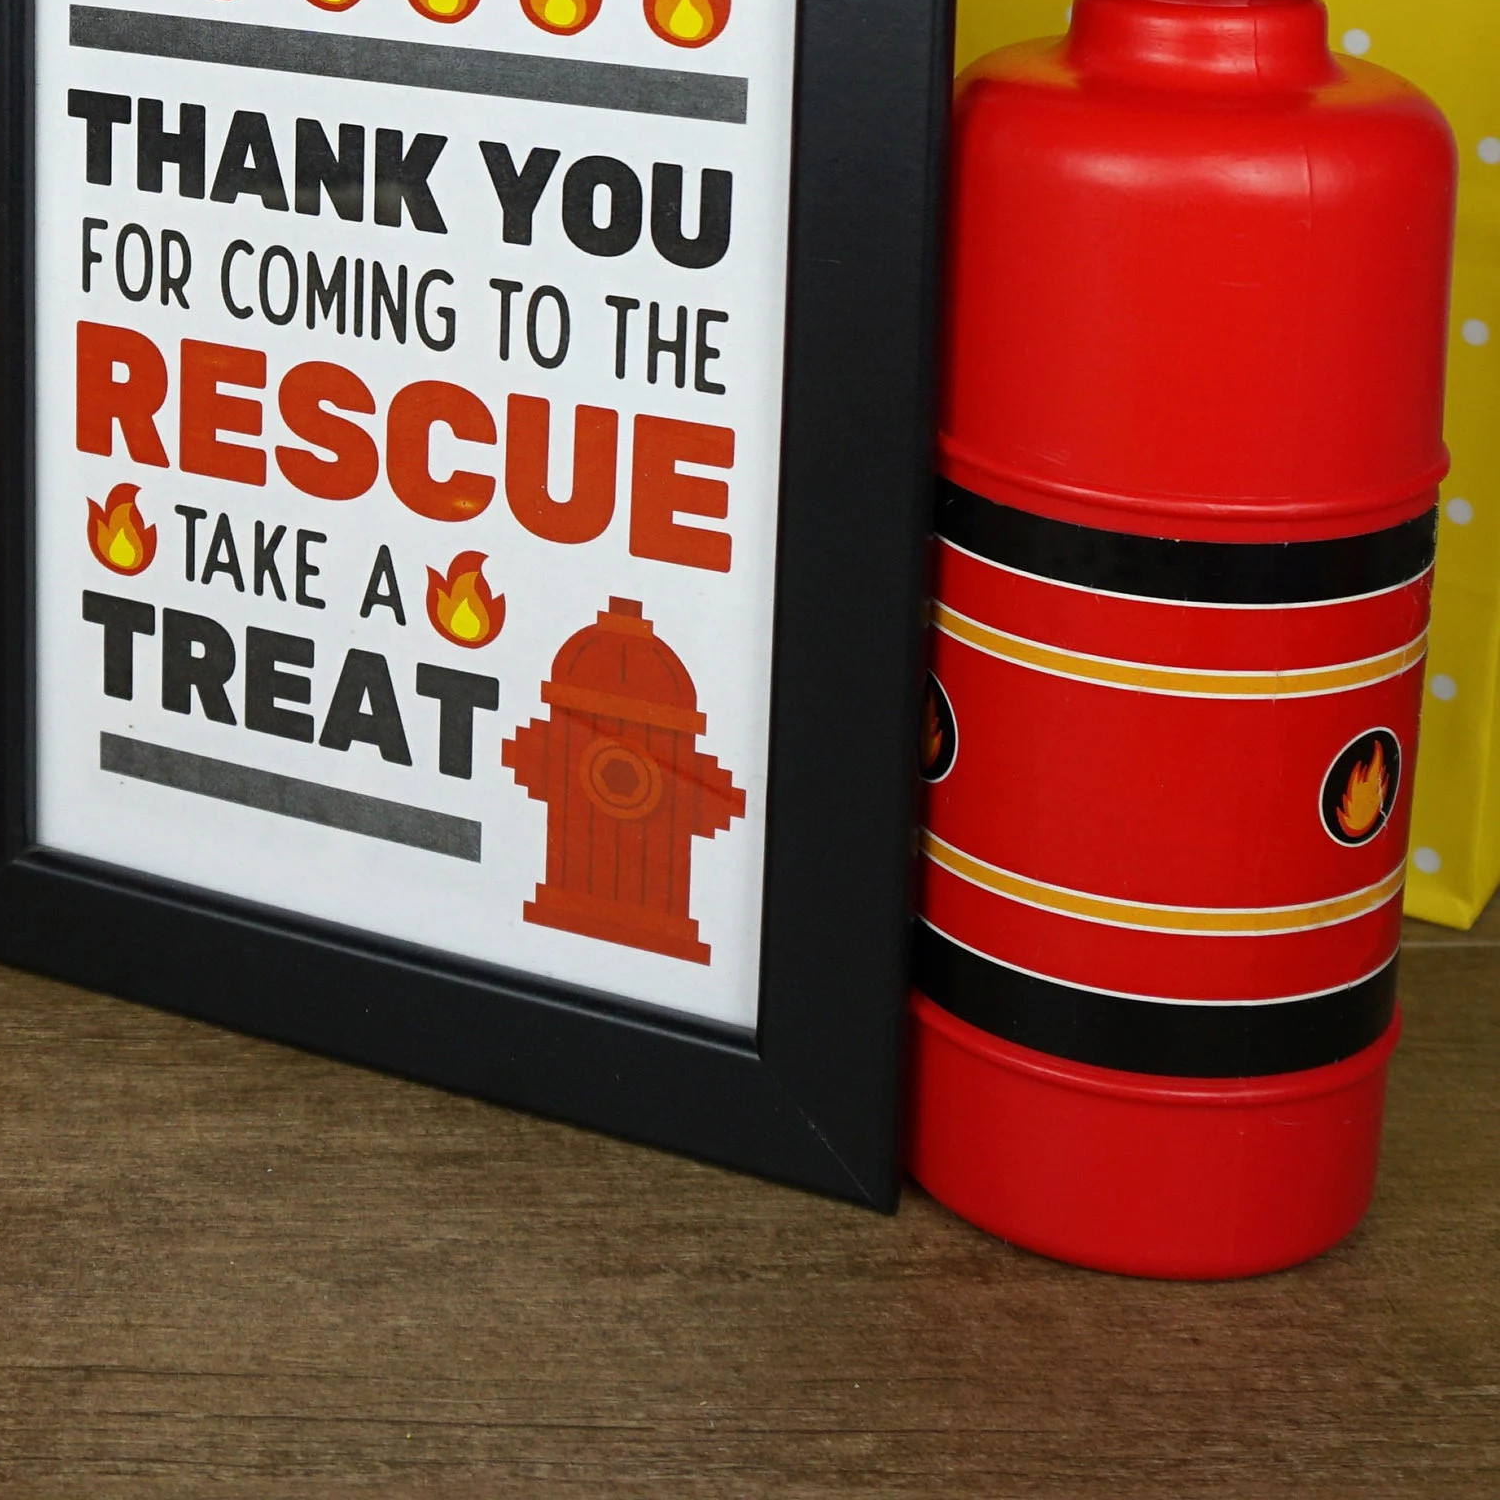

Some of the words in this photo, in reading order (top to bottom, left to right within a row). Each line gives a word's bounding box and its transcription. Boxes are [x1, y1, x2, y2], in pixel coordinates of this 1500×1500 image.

[67, 88, 448, 234] THANK
[479, 140, 733, 269] YOU
[82, 216, 192, 309] FOR
[220, 239, 457, 352] COMING
[489, 278, 571, 369] TO
[605, 294, 729, 395] THE
[76, 320, 735, 573] RESCUE
[175, 504, 327, 610] TAKE
[360, 544, 406, 626] A
[82, 589, 499, 779] TREAT
